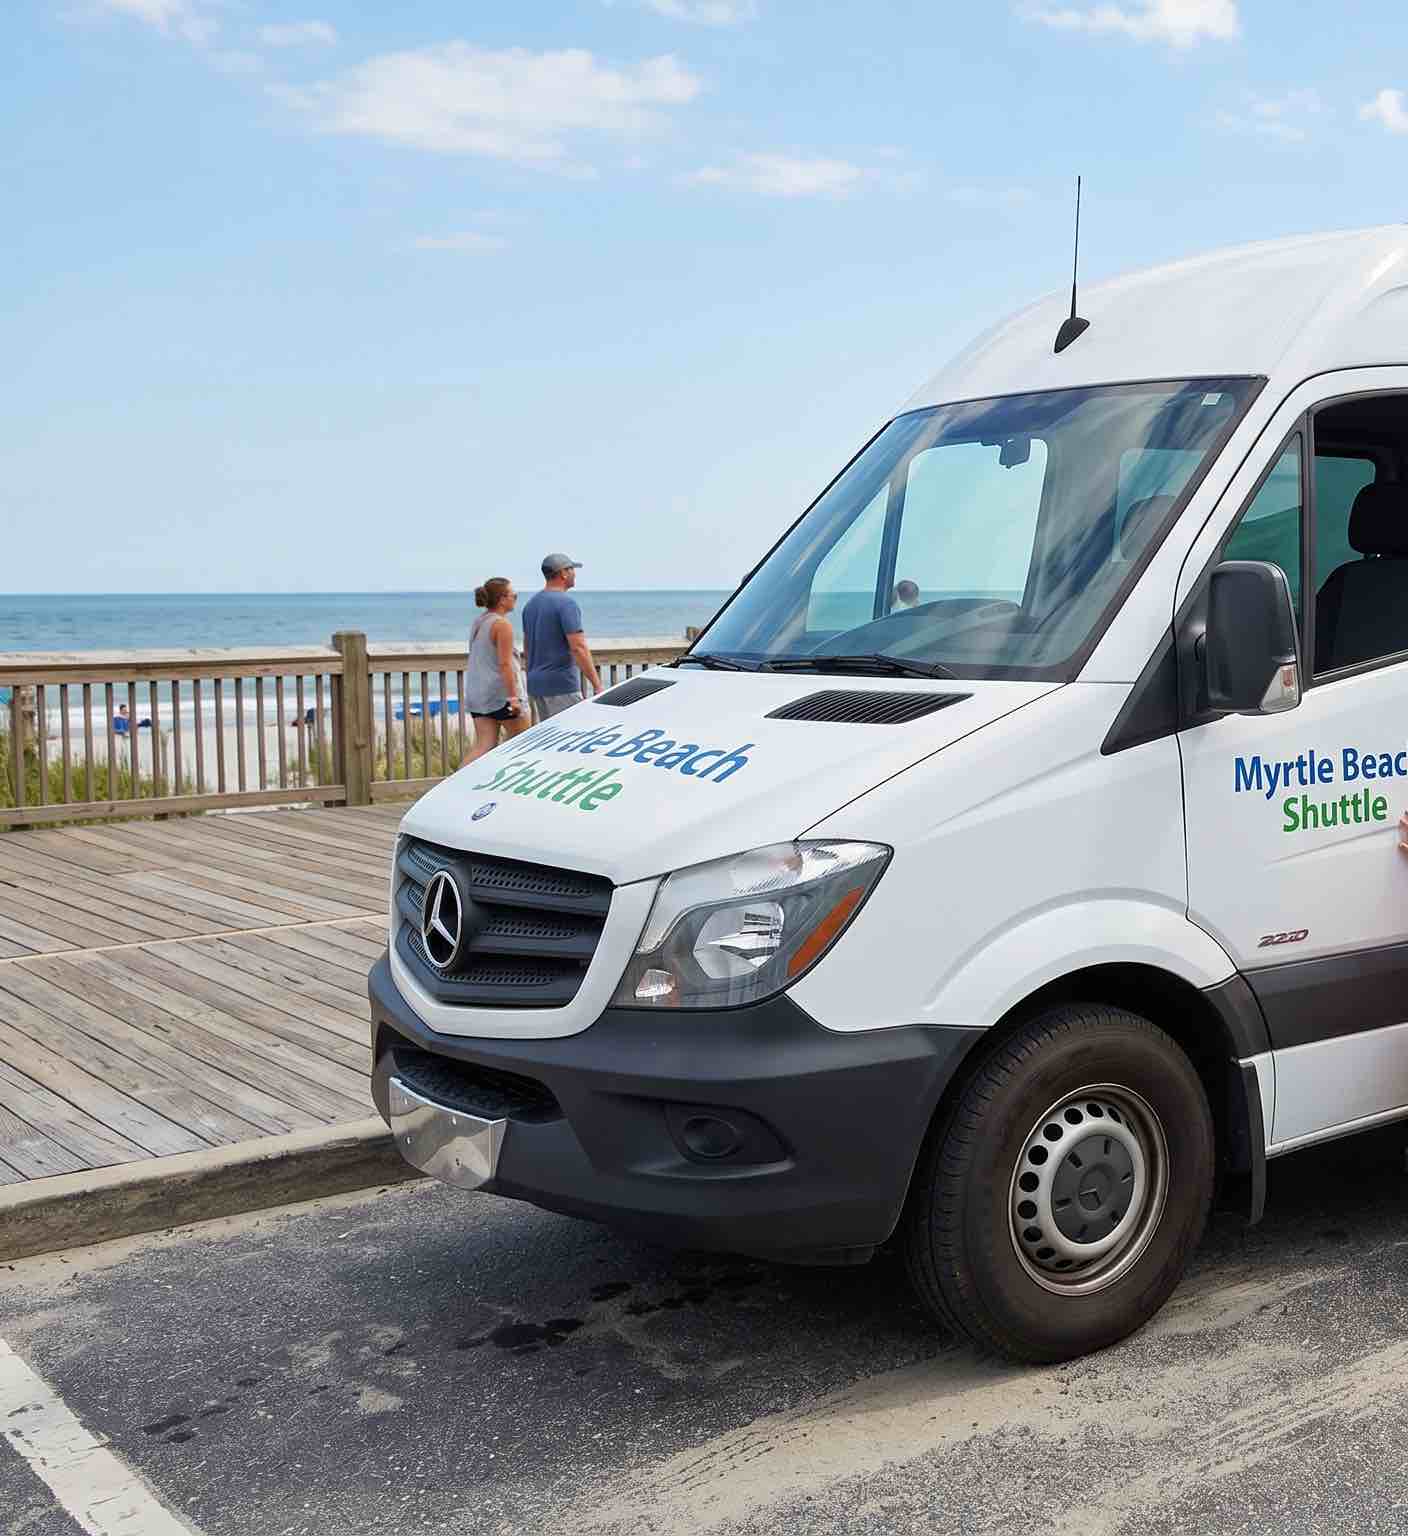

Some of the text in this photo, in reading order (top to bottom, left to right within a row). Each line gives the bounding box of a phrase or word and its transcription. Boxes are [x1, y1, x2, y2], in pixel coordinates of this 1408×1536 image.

[497, 723, 756, 784] Myrtle Beach
[1233, 749, 1335, 800] Myrtle
[471, 759, 624, 812] Shuttle
[1282, 787, 1388, 833] Shuttle
